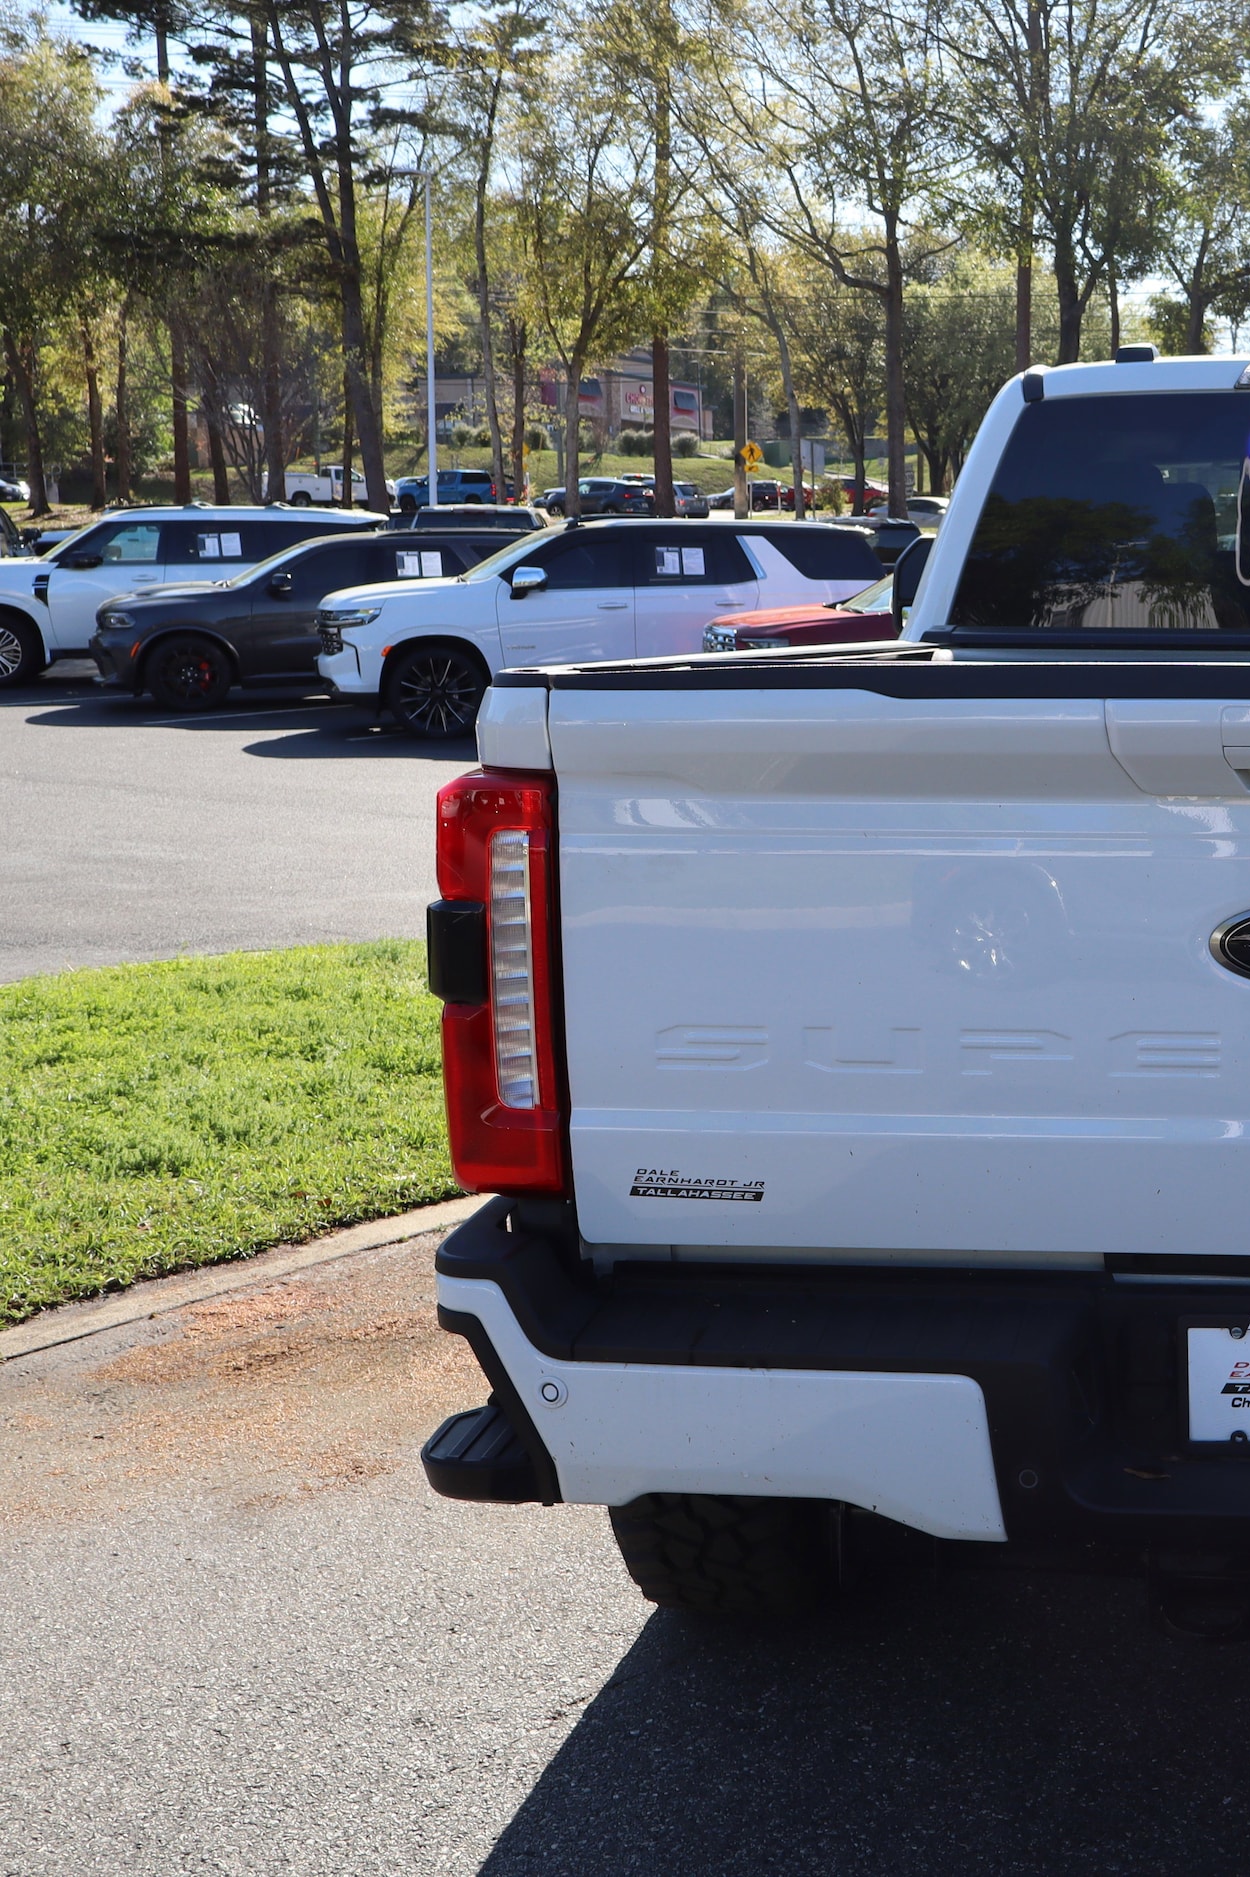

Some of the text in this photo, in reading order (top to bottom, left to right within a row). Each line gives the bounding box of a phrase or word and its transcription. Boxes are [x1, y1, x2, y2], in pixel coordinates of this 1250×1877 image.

[637, 1169, 679, 1177] DALE
[634, 1176, 765, 1190] EARNHARDT JR
[637, 1187, 756, 1200] TALLAHASSEE
